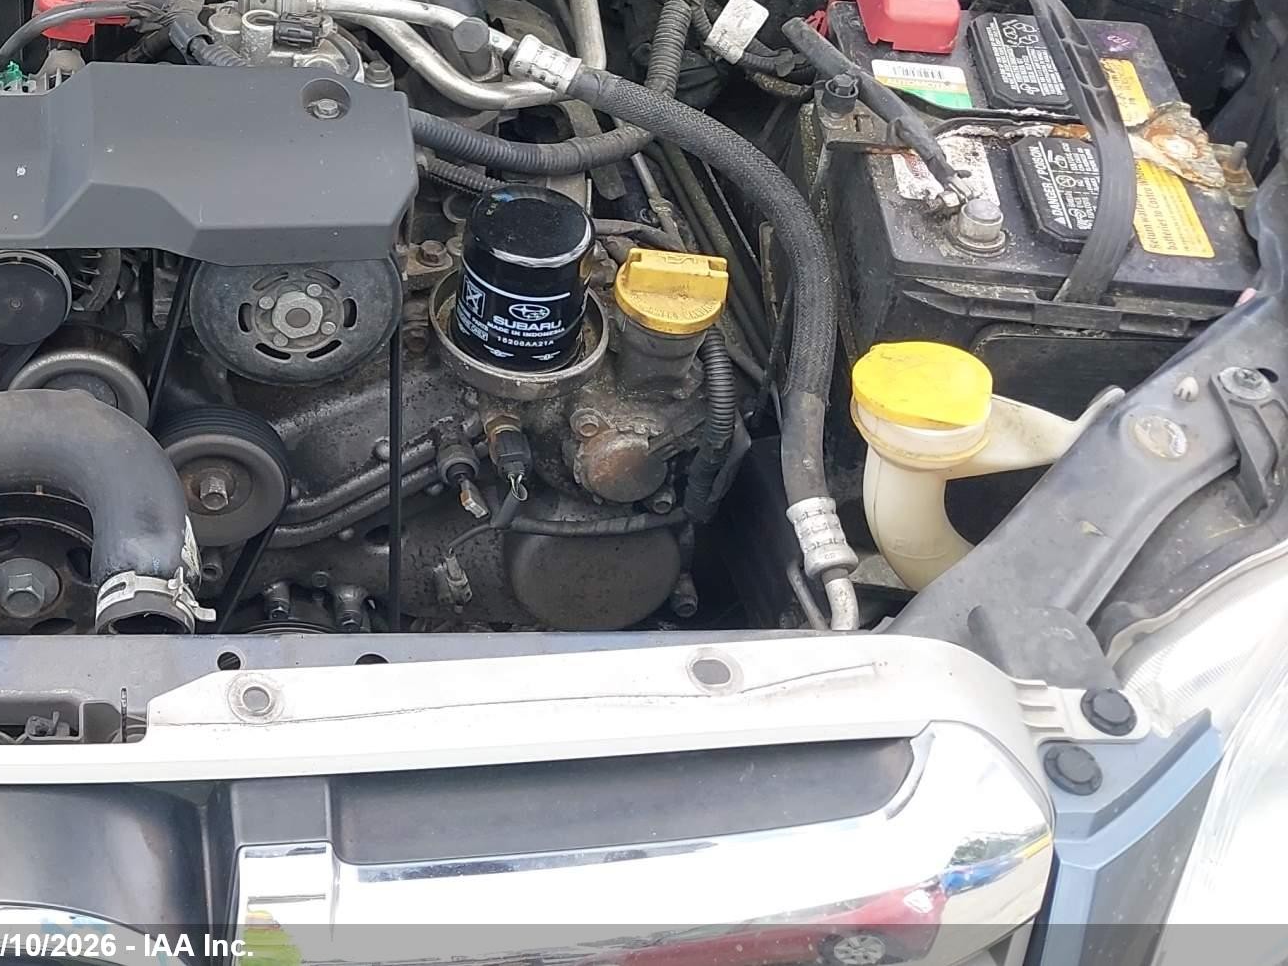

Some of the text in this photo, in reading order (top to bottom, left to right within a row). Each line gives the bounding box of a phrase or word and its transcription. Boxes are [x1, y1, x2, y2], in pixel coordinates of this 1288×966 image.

[1028, 146, 1049, 175] POISON
[1042, 182, 1064, 216] DANGER
[487, 321, 510, 334] MADE
[523, 327, 566, 337] INDONESIA
[492, 315, 563, 332] SUBARU
